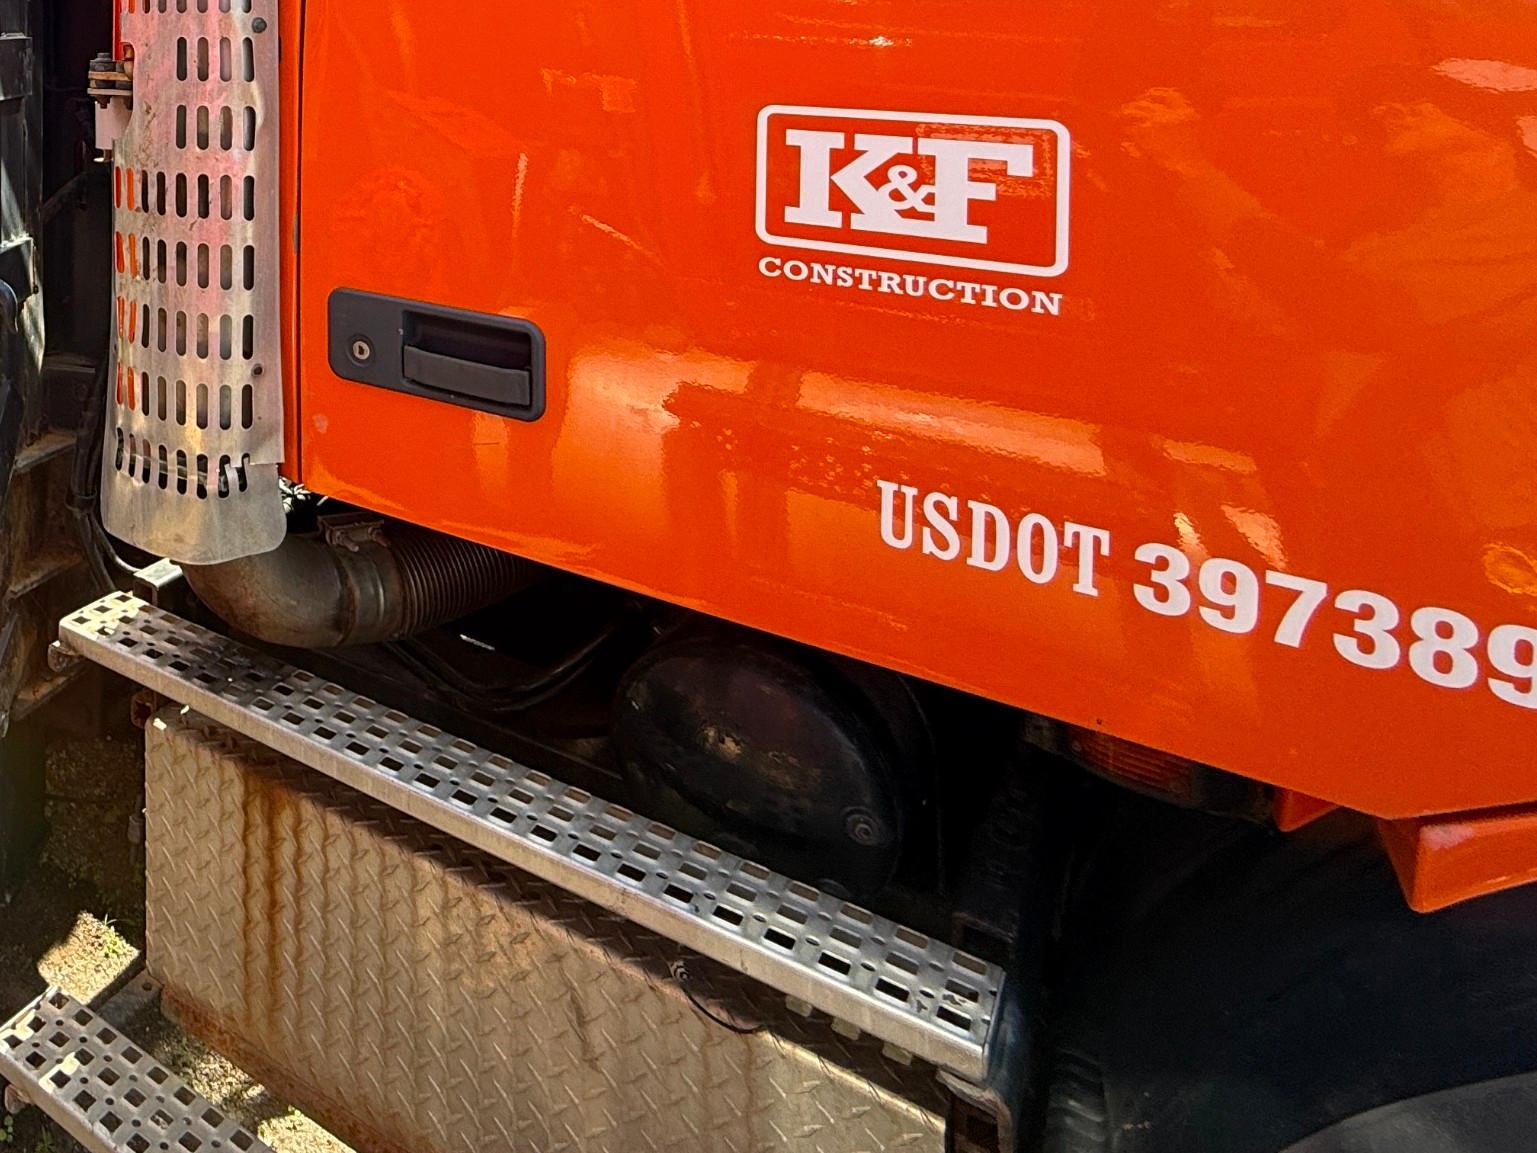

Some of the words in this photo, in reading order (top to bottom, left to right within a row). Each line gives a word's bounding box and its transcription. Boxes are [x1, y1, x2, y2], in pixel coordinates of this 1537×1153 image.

[784, 129, 1034, 244] K&F
[758, 256, 1063, 315] CONSTRUCTION
[876, 480, 1111, 597] USDOT
[1133, 543, 1537, 710] 397389
